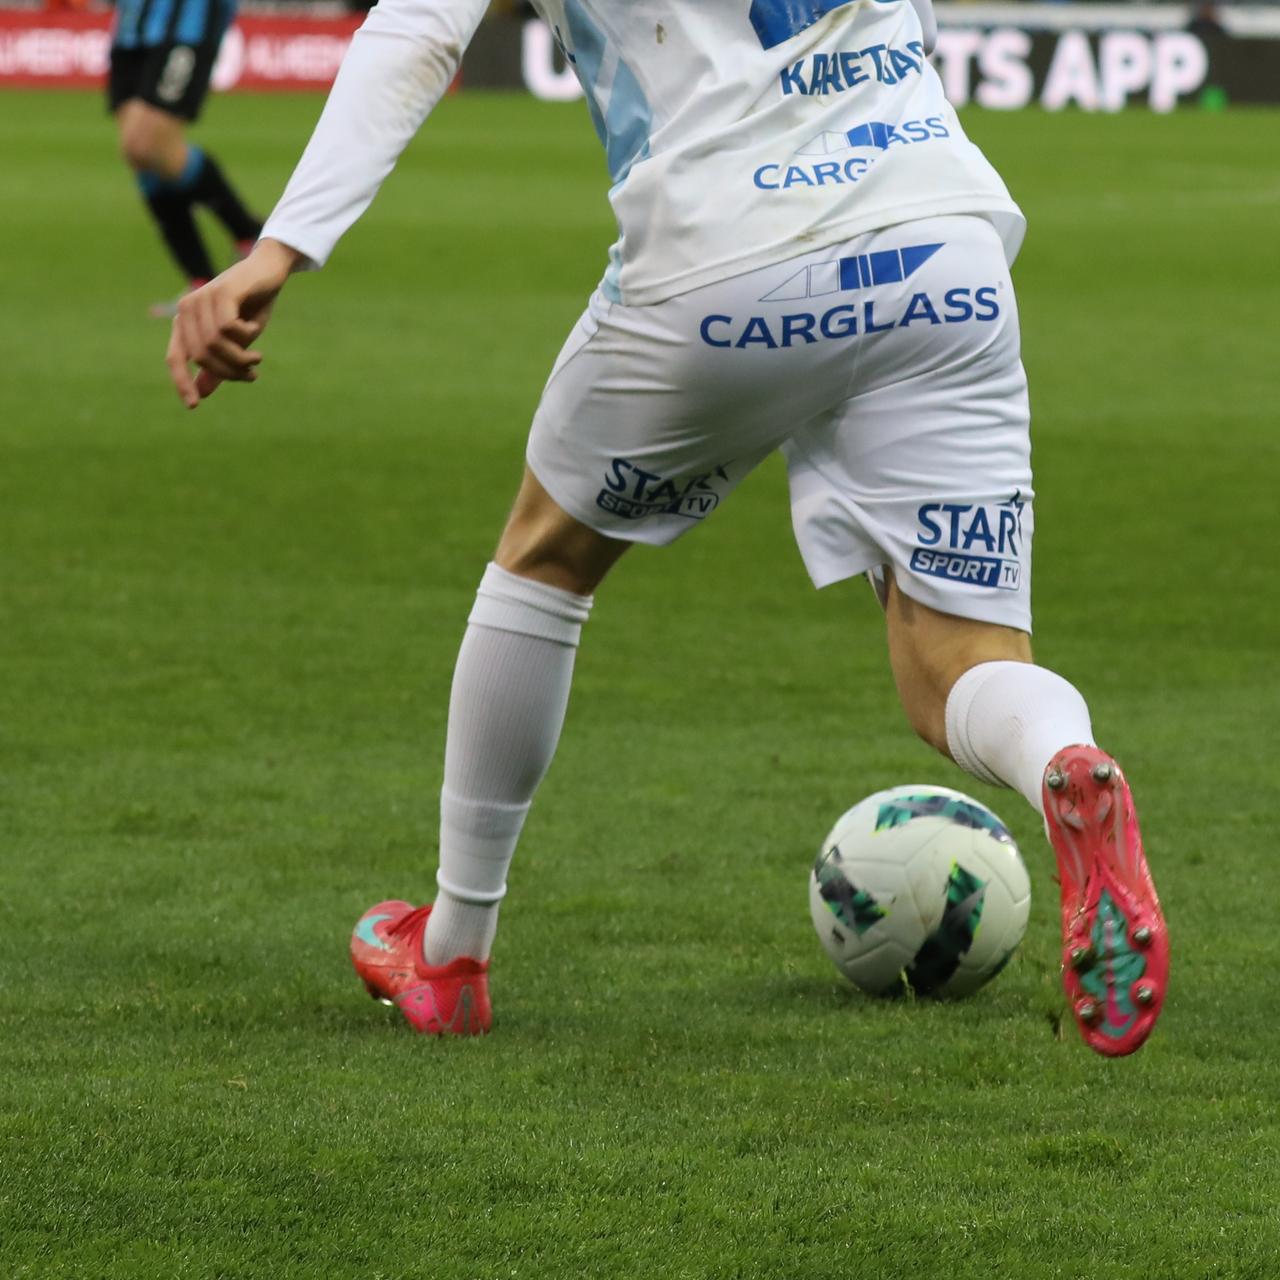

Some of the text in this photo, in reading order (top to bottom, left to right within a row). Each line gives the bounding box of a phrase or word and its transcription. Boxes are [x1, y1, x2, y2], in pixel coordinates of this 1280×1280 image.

[1042, 30, 1208, 113] APP
[753, 117, 950, 190] CARGASS
[699, 287, 1000, 349] CARGLASS
[687, 497, 712, 512] TV
[917, 504, 1018, 556] STAR
[915, 550, 1019, 583] SPORT TV
